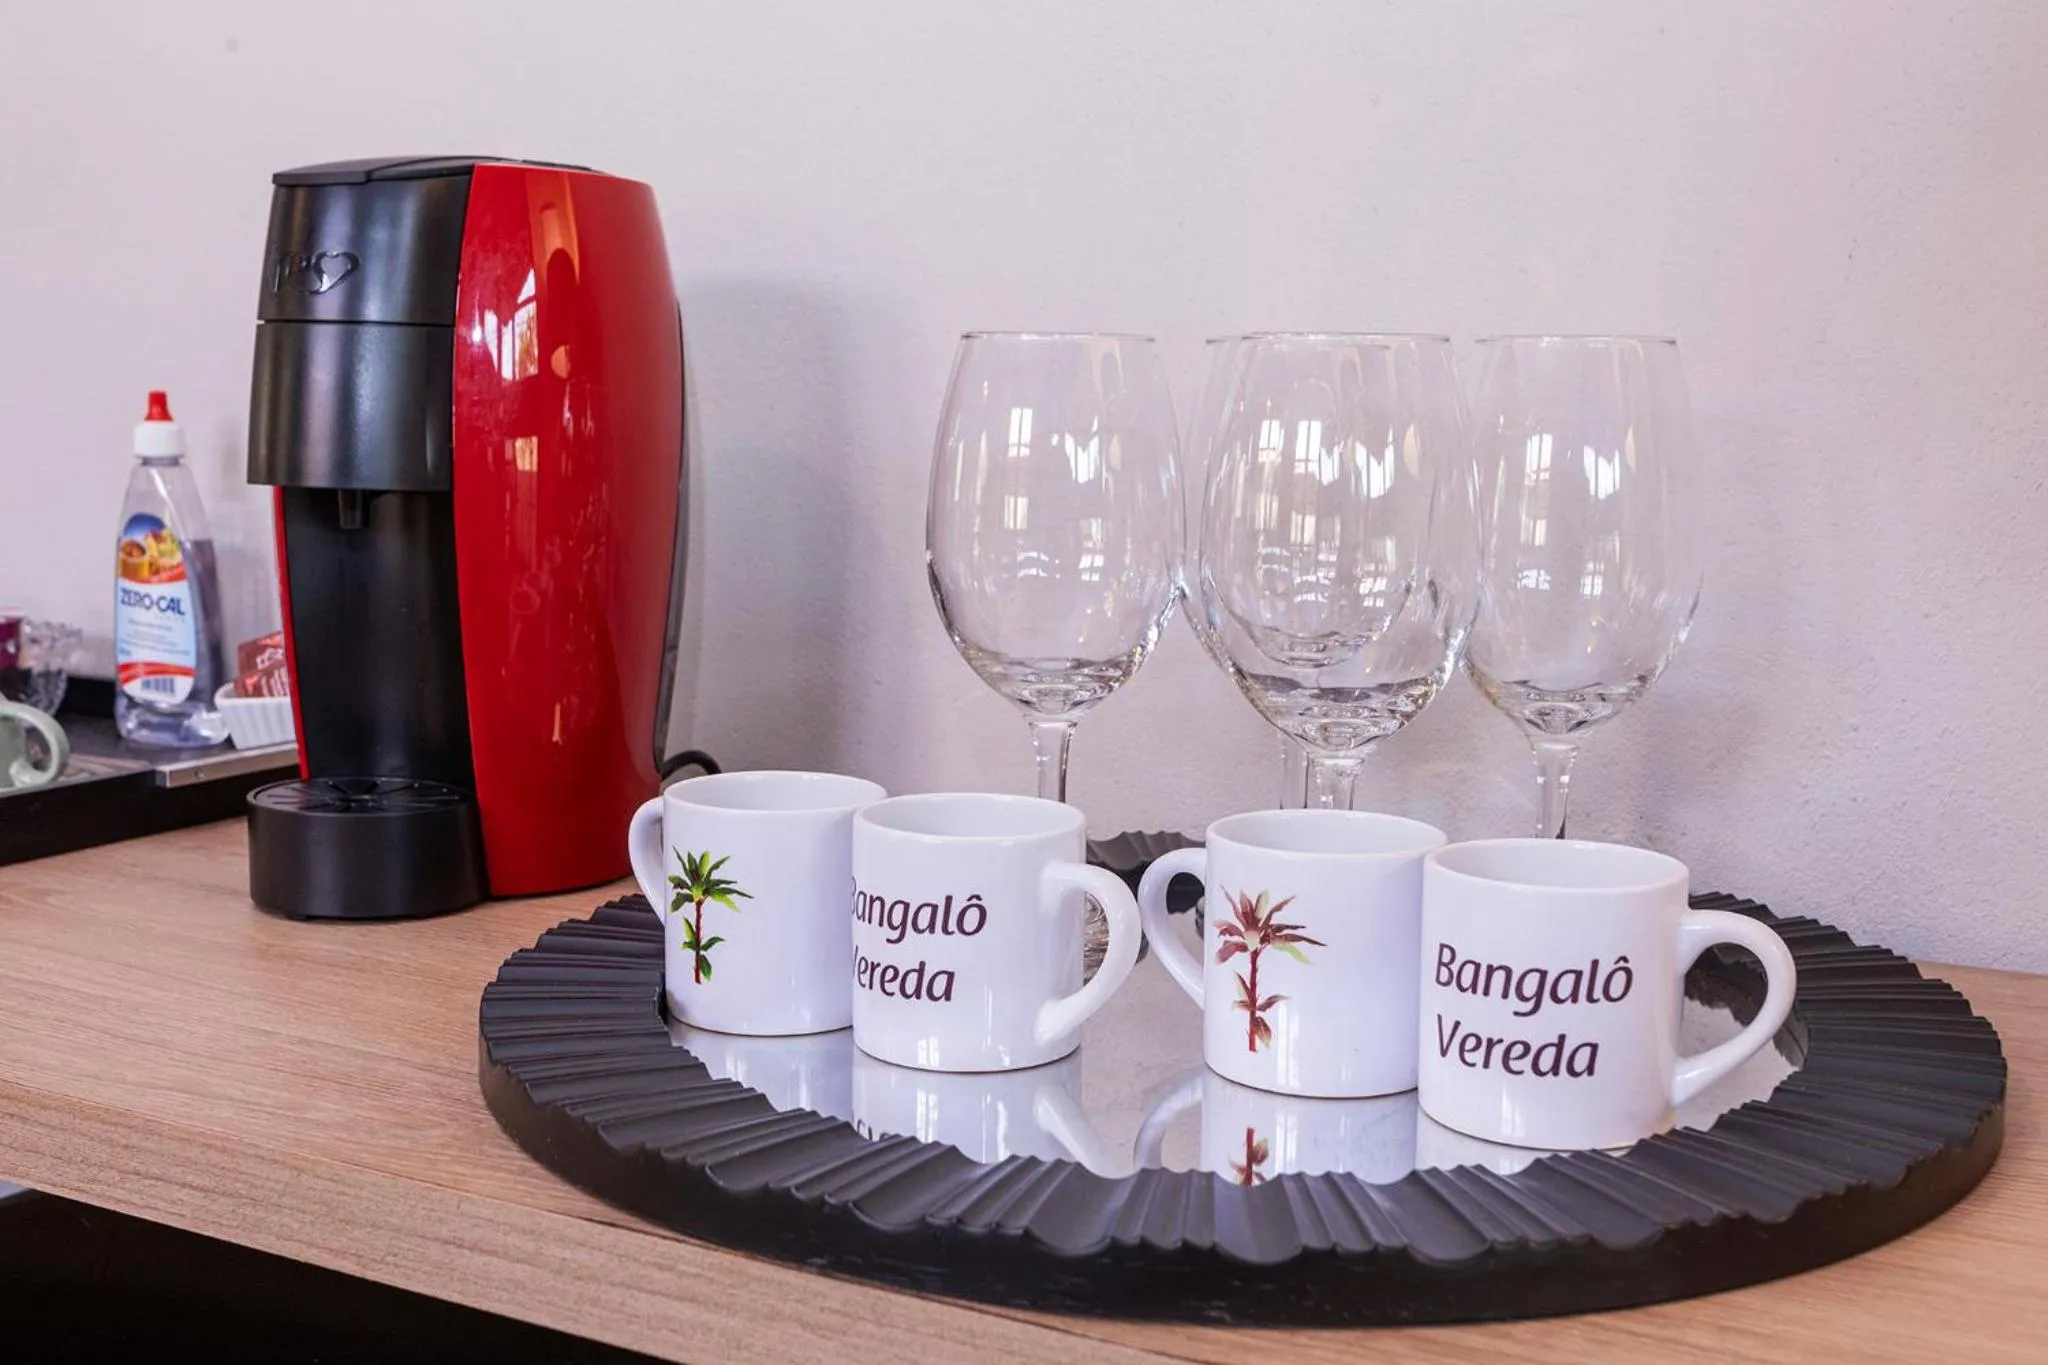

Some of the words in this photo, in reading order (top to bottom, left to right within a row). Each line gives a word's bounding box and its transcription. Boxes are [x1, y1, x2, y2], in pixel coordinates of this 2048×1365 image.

[120, 588, 186, 616] ZERO-CAL
[1435, 943, 1633, 1017] Bangalô
[1437, 1013, 1599, 1078] Vereda
